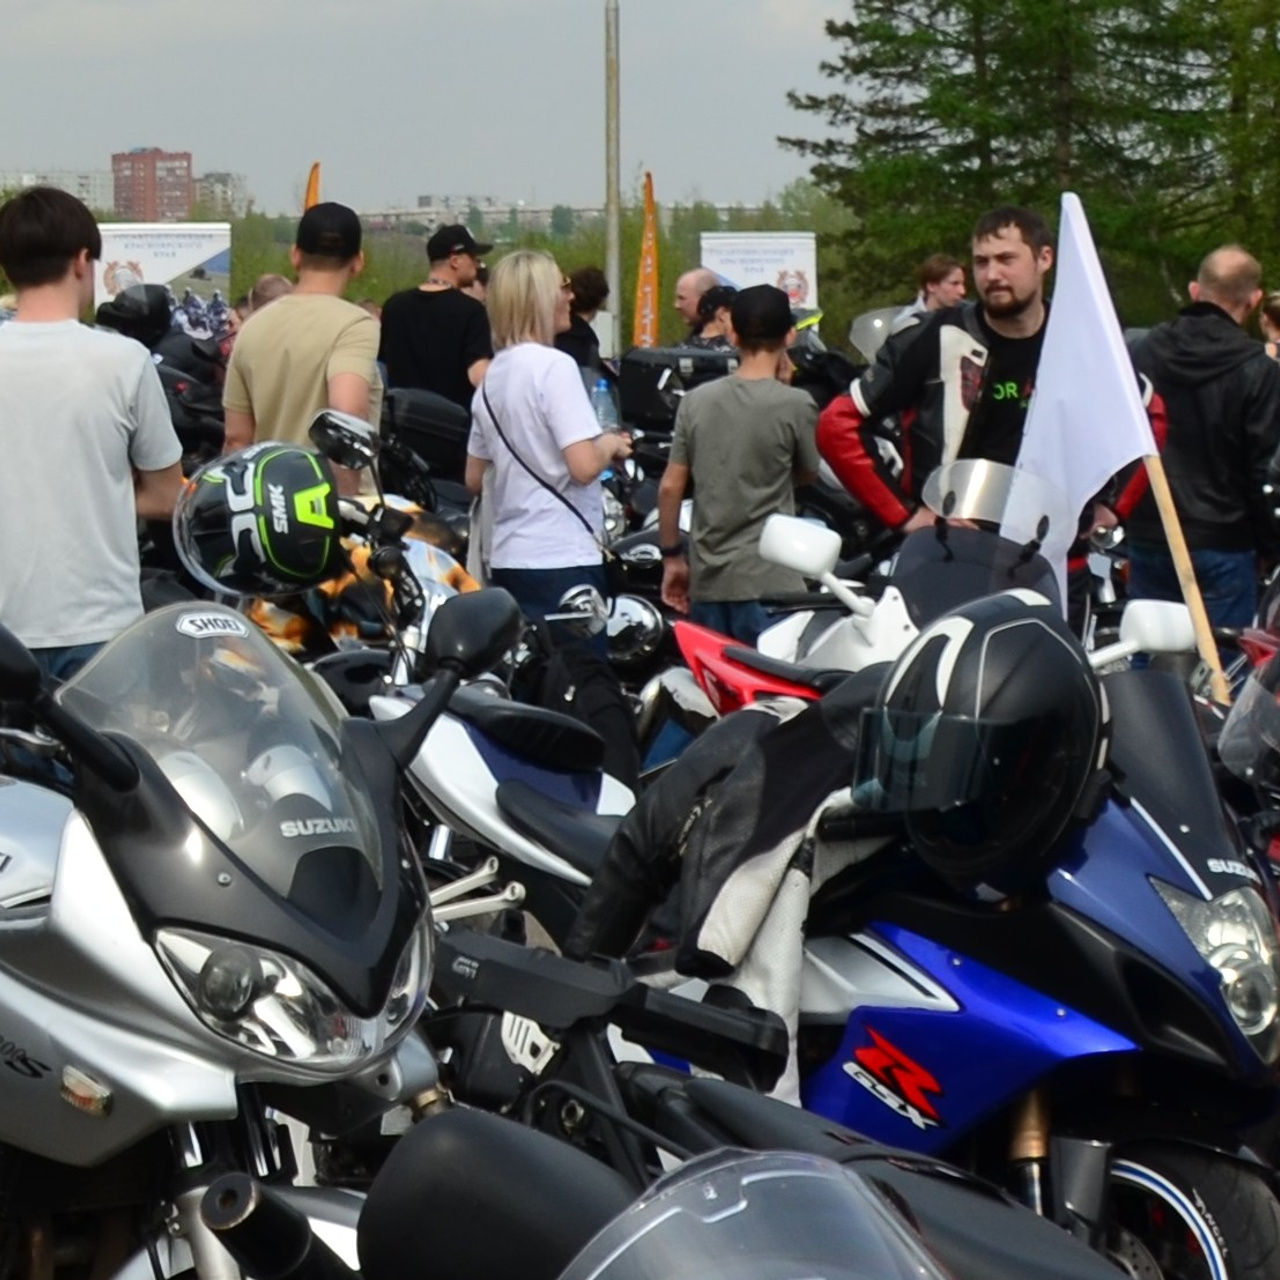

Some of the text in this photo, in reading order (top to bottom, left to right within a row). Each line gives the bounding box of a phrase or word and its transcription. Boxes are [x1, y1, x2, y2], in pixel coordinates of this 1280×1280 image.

[268, 483, 289, 534] SMK
[189, 618, 240, 632] SHOEI
[280, 818, 358, 838] SUZUKI
[842, 1060, 940, 1131] GSX
